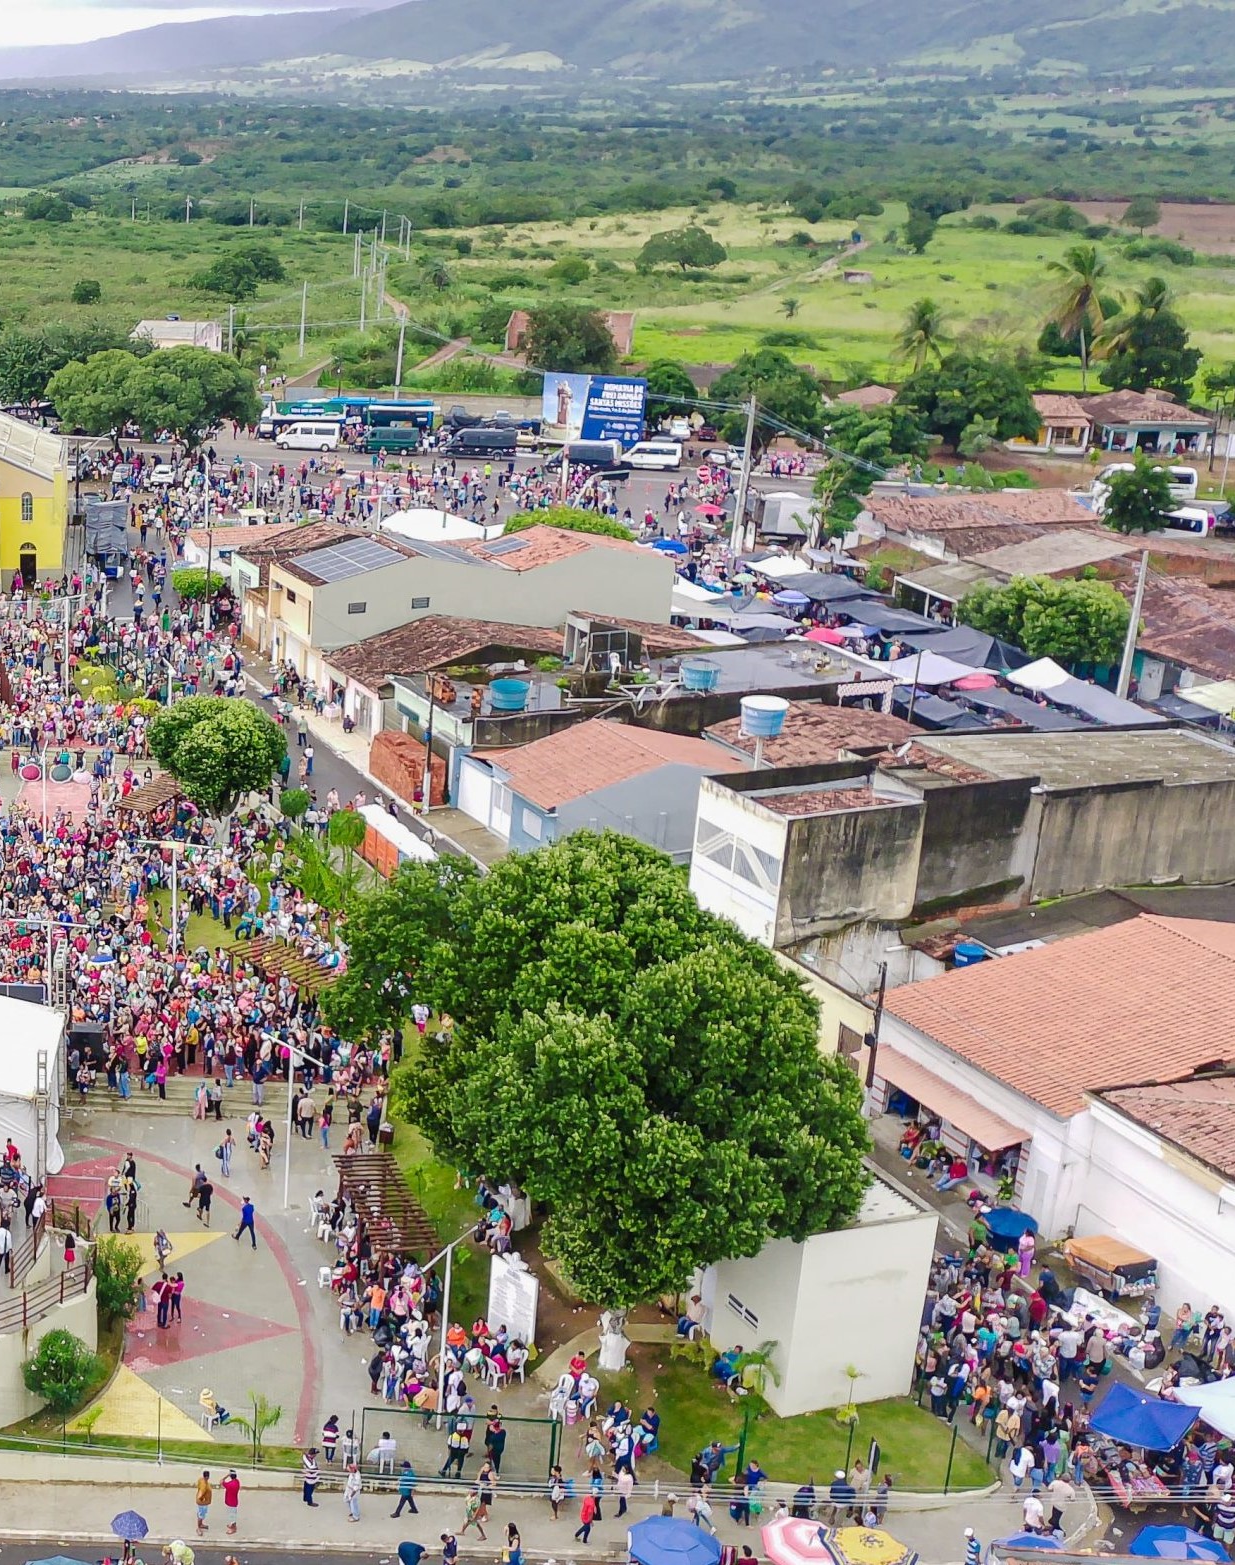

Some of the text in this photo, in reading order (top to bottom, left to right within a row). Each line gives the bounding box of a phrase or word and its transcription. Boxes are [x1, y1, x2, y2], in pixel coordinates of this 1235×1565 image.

[604, 383, 634, 393] ROMARIA
[601, 391, 616, 400] FREI
[589, 398, 642, 409] SANTAS MISSÕES
